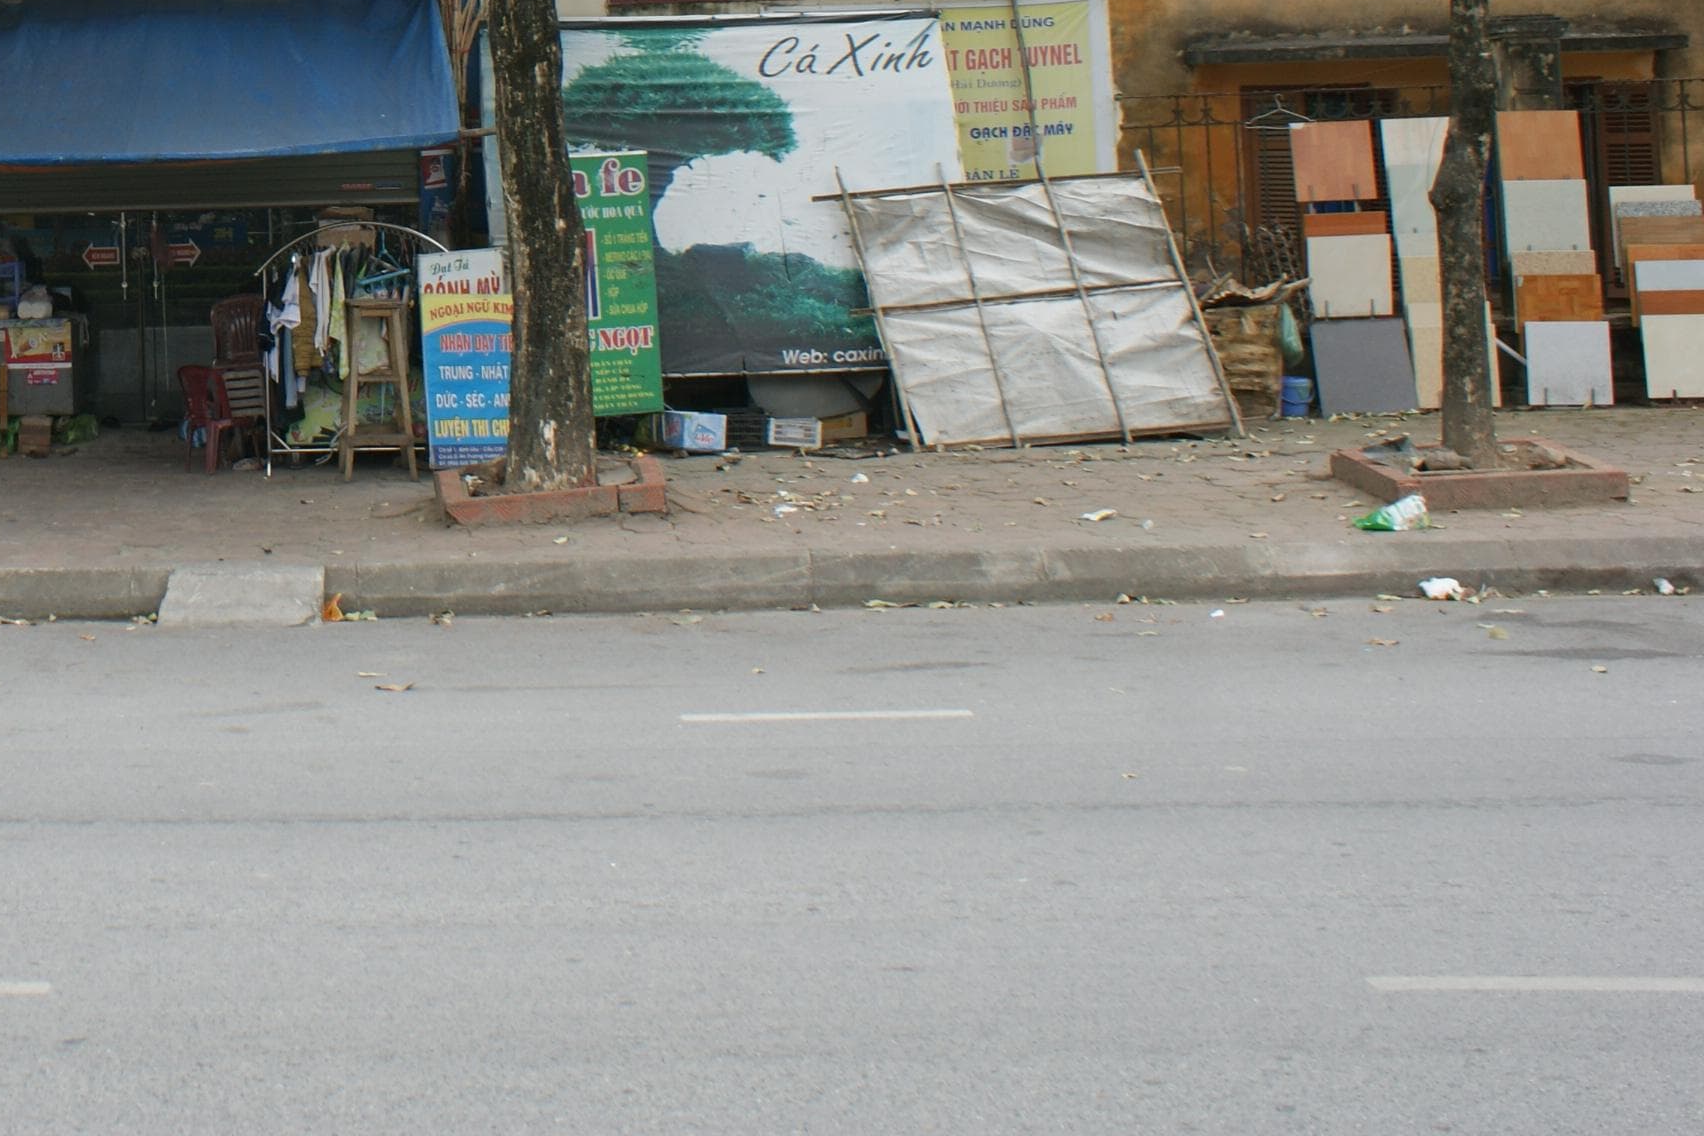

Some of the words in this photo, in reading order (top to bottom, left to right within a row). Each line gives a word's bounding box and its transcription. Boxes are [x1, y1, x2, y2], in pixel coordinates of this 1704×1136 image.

[960, 20, 1006, 33] MẠNH
[758, 36, 820, 78] Cá
[826, 32, 933, 77] Xinh
[965, 47, 1012, 74] GẠCH
[974, 97, 1008, 115] THIỆU
[1041, 92, 1077, 110] PHẨM
[969, 126, 1008, 142] GẠCH
[599, 157, 646, 197] fe
[429, 304, 465, 321] NGOẠI
[439, 331, 473, 357] NHẬN
[597, 324, 654, 356] NGỌT
[782, 348, 828, 364] Web:
[438, 365, 474, 380] TRUNG
[481, 361, 509, 384] NHẬT
[434, 415, 469, 442] LUYỆN
[471, 418, 490, 438] THI
